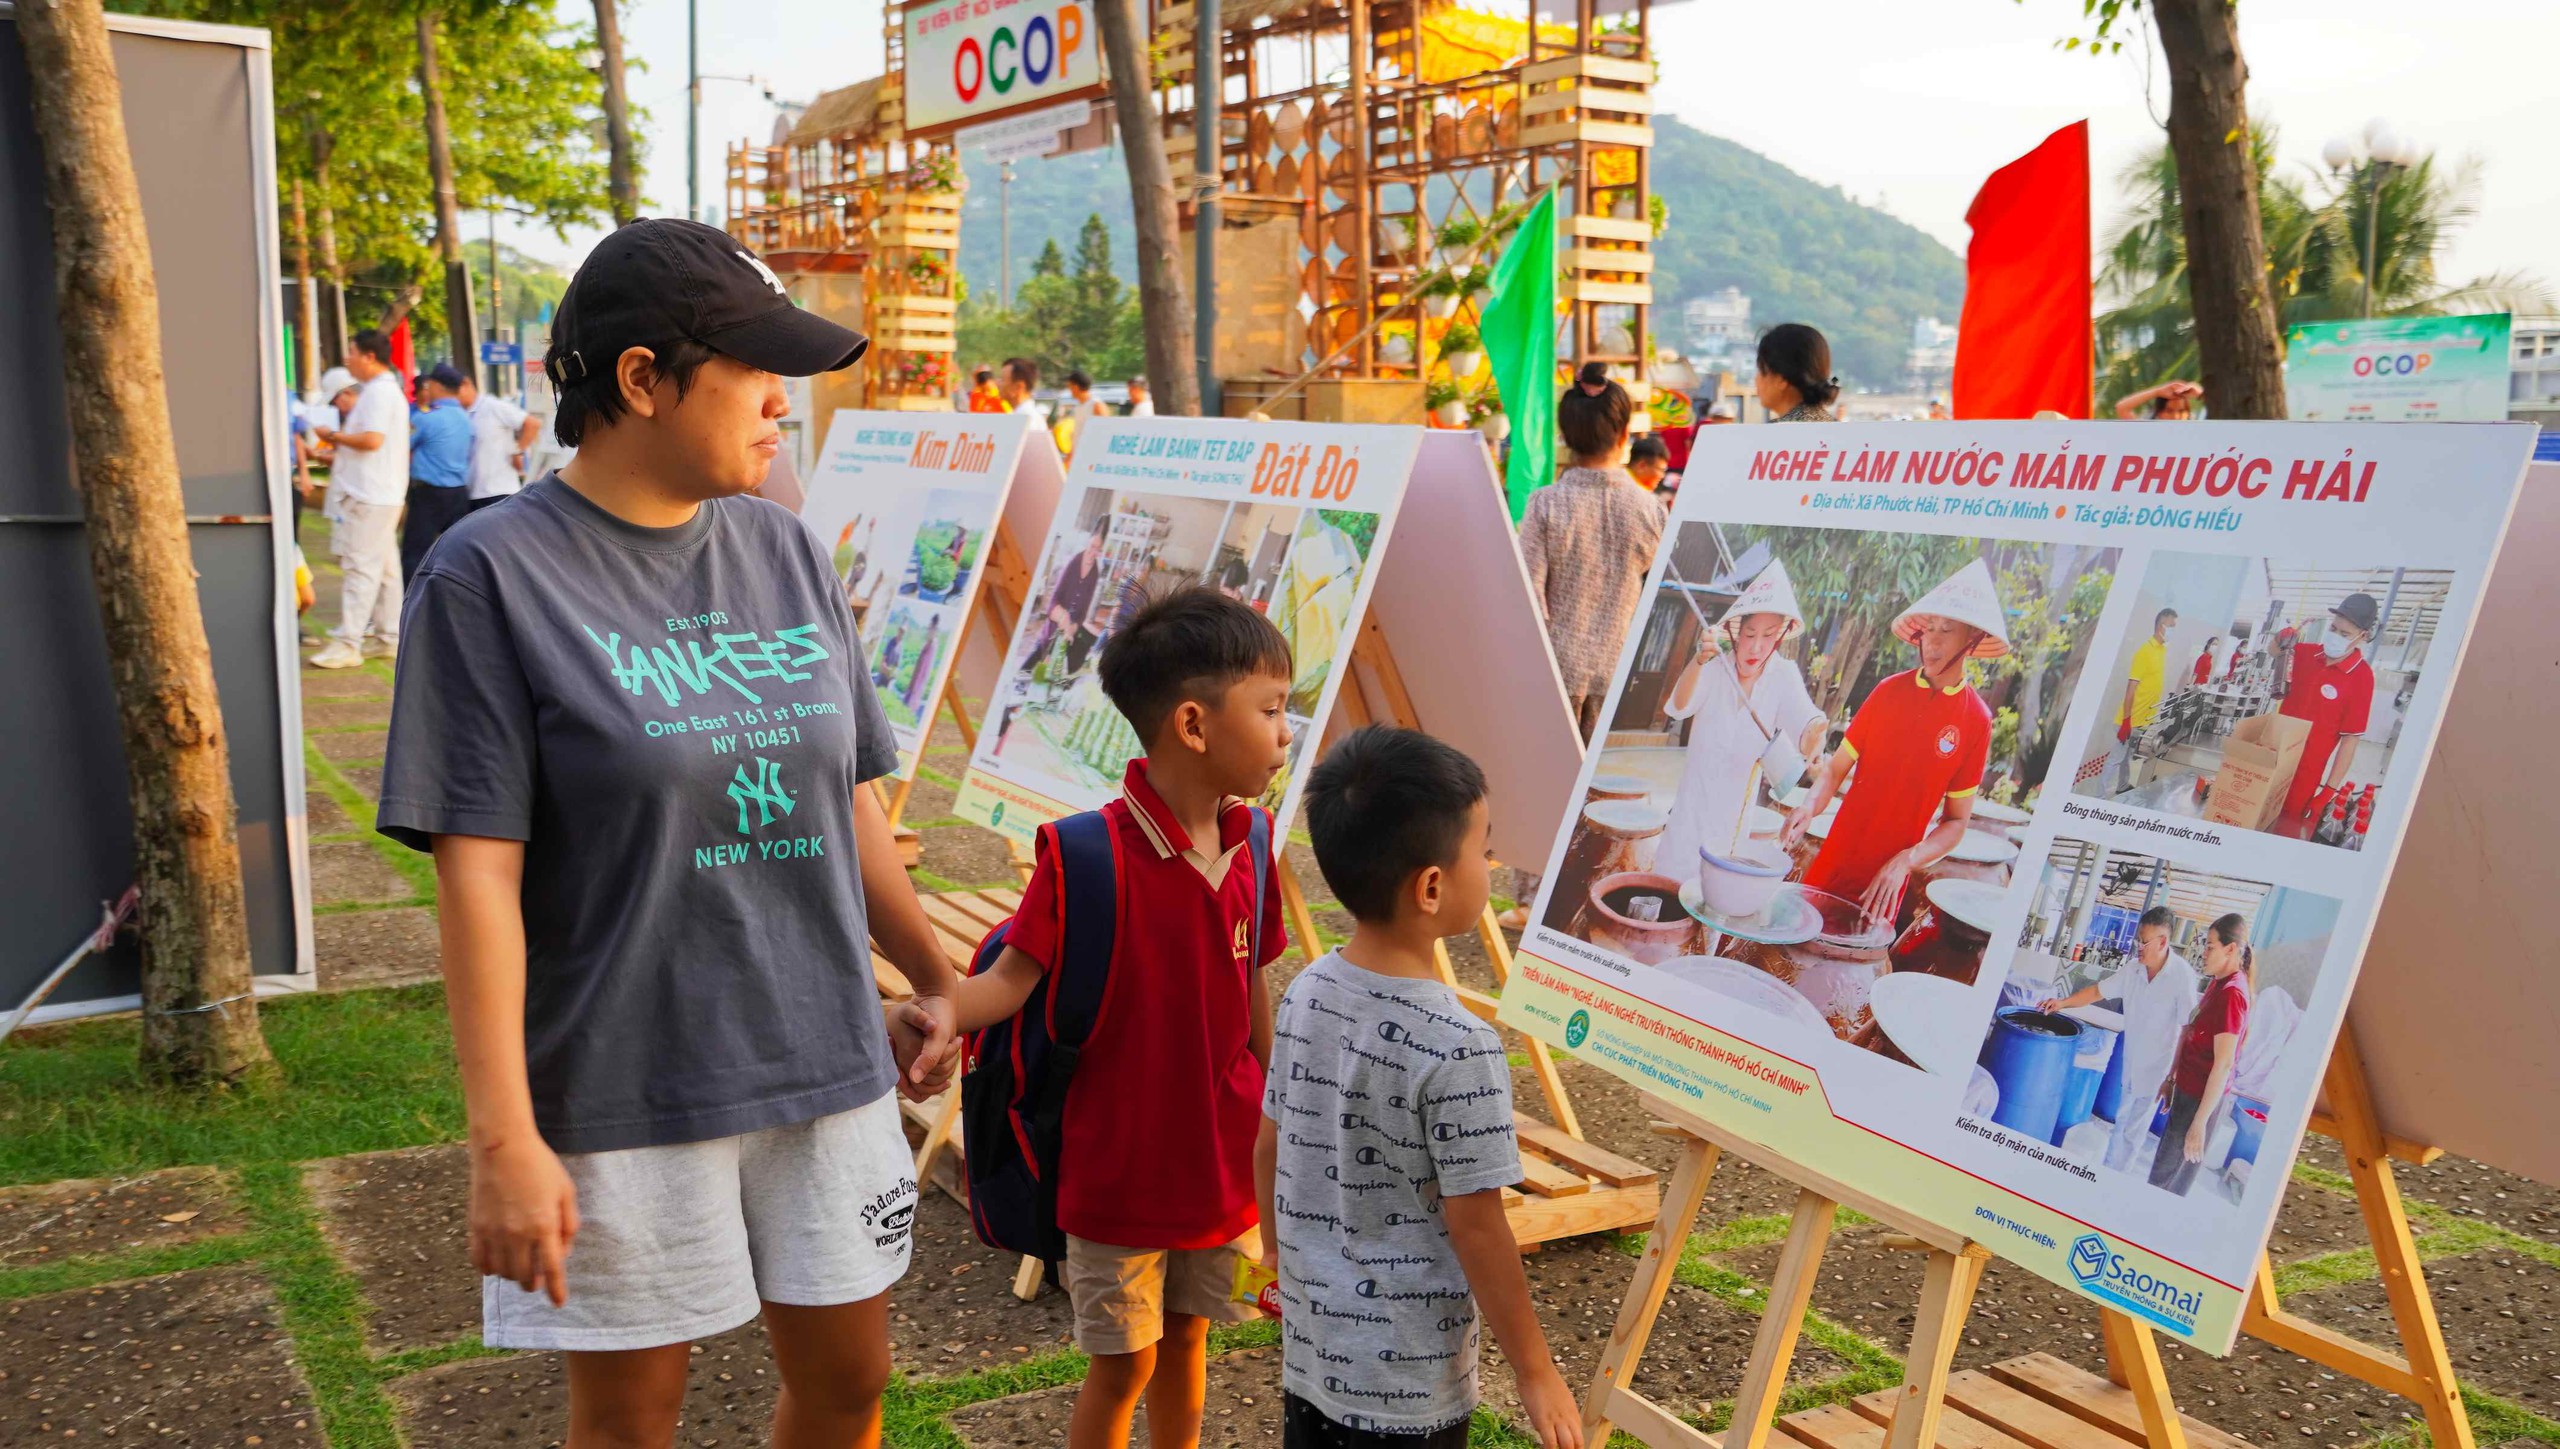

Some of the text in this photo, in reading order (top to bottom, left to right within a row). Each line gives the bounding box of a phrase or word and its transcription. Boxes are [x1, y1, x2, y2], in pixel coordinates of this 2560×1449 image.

[954, 4, 1083, 104] OCOP
[2353, 353, 2432, 377] OCOP
[909, 430, 949, 470] Kim
[1250, 442, 1360, 503] Đất Đỏ
[1748, 439, 2378, 503] NGHỀ LÀM NƯỚC MẮM PHƯỚC HẢI
[1812, 492, 1830, 513] Địa
[1833, 493, 1855, 511] chỉ:
[1856, 494, 1872, 511] Xã
[1874, 494, 1911, 513] Phước
[1914, 495, 1940, 515] Hải,
[1943, 498, 1961, 515] TP
[1961, 495, 1983, 517] Hồ
[1984, 498, 2011, 518] Chí
[2009, 501, 2049, 520] Minh
[2074, 504, 2100, 523] Tác
[2102, 504, 2133, 530] giả:
[2135, 504, 2192, 529] ĐÔNG
[665, 612, 729, 632] Est.1903
[582, 622, 830, 707] YANKEES
[645, 702, 842, 738] One East 161 st Bronx,
[711, 726, 801, 755] NY 10451
[2063, 802, 2222, 846] Đóng thùng sản phẩm nước mắm.
[695, 835, 825, 869] NEW YORK
[1340, 1035, 1408, 1072] Champion
[1593, 996, 1614, 1014] LÀNG
[1613, 1007, 1637, 1024] NGHỀ
[1635, 1014, 1667, 1038] TRUYỀN
[1666, 1026, 1695, 1049] THỐNG
[1695, 1039, 1726, 1062] THÀNH
[1726, 1052, 1747, 1071] PHỐ
[1746, 1061, 1762, 1077] HỒ
[1761, 1067, 1779, 1085] CHÍ
[1289, 1062, 1370, 1101] Chamion
[1591, 1041, 1604, 1053] CHI
[1617, 1053, 1638, 1068] PHÁT
[1637, 1061, 1658, 1079] TRIỂN
[1657, 1071, 1681, 1090] NÔNG
[1681, 1083, 1705, 1100] THÔN
[1739, 1092, 1753, 1106] CHÍ
[1752, 1099, 1772, 1114] MINH
[1955, 1116, 2097, 1183] Kiểm tra độ mặn của nước mắm.
[1975, 1206, 2057, 1250] ĐƠN VỊ THỰC HIỆN:
[1342, 1246, 1436, 1271] Campion
[1356, 1279, 1470, 1307] Campion
[2102, 1279, 2131, 1296] TRUYỀN
[2131, 1292, 2157, 1309] THÔNG
[2176, 1312, 2196, 1326] KIỆN
[2106, 1254, 2203, 1315] Saomai
[1310, 1300, 1393, 1327] Champion
[1378, 1350, 1458, 1365] Champion
[1323, 1376, 1431, 1404] Champion
